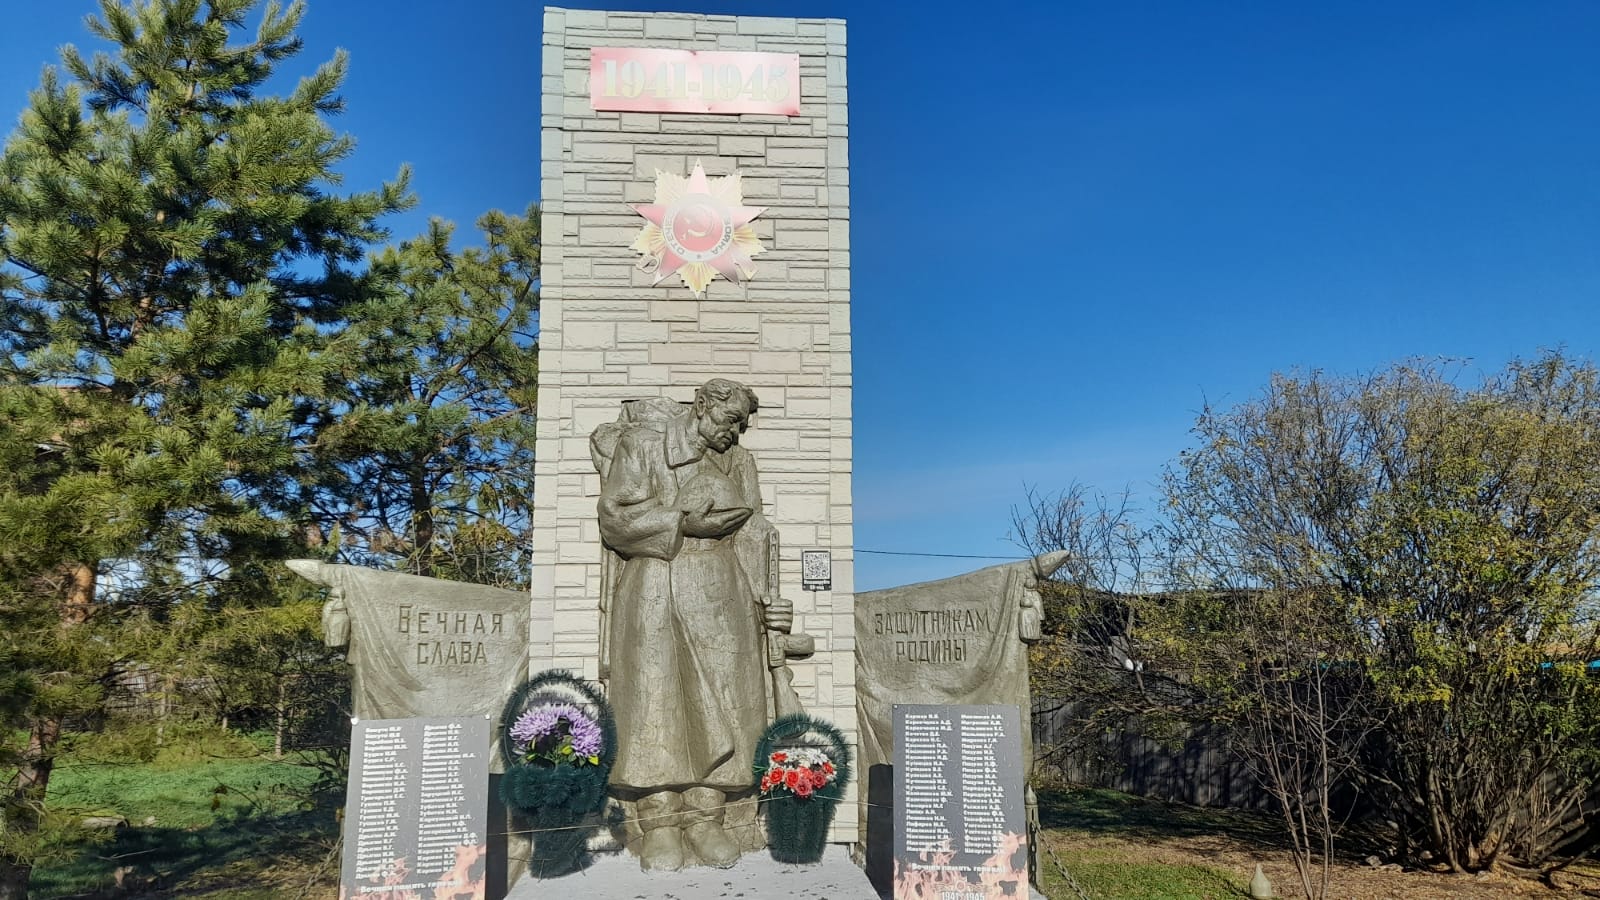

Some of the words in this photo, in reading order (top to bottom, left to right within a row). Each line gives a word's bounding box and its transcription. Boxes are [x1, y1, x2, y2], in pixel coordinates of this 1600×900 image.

[601, 59, 790, 104] 1941-1945
[398, 605, 503, 634] ВЕЧНАЯ
[874, 609, 990, 635] ЗАЩИТНИКАМ
[417, 641, 488, 665] СЛАВА
[895, 638, 967, 663] РОДИНЫ
